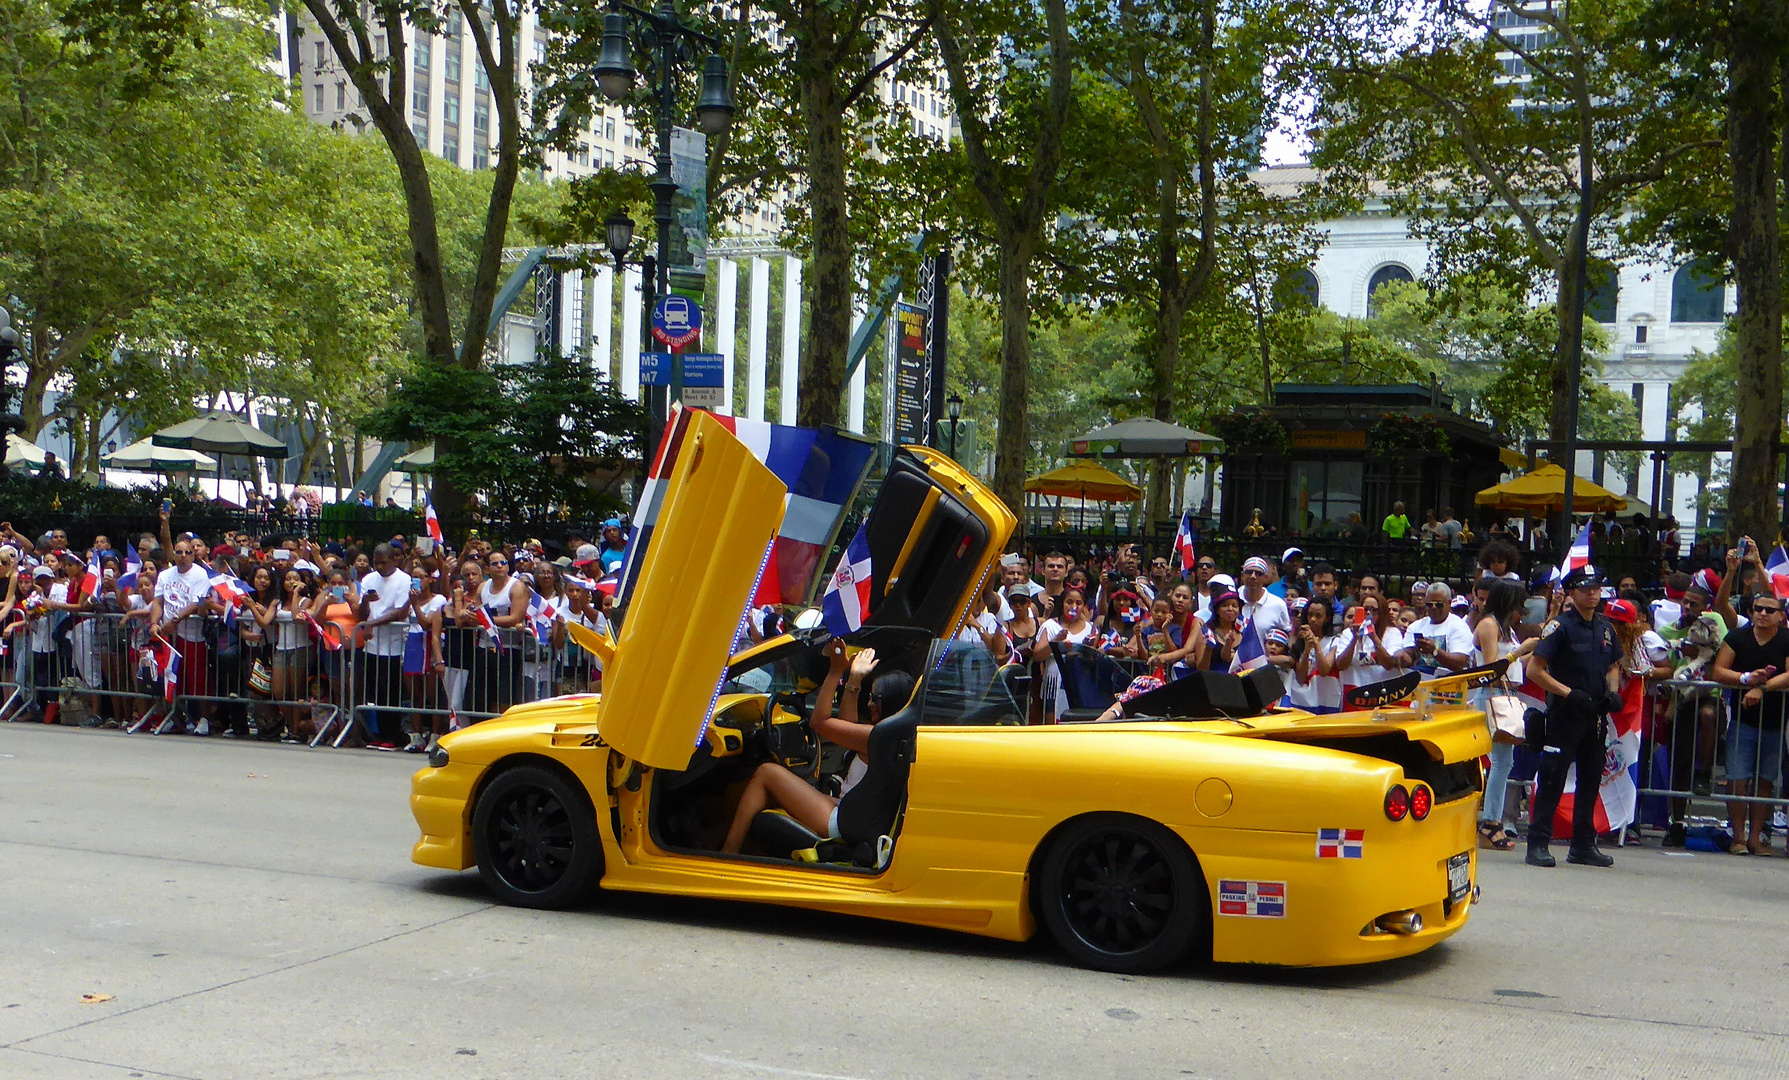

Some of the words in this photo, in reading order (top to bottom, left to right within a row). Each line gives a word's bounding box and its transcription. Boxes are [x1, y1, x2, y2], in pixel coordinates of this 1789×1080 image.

[656, 329, 666, 340] NO
[666, 329, 698, 344] STANDING
[641, 354, 659, 367] M5
[641, 370, 658, 383] M7
[1355, 686, 1407, 706] DANNY
